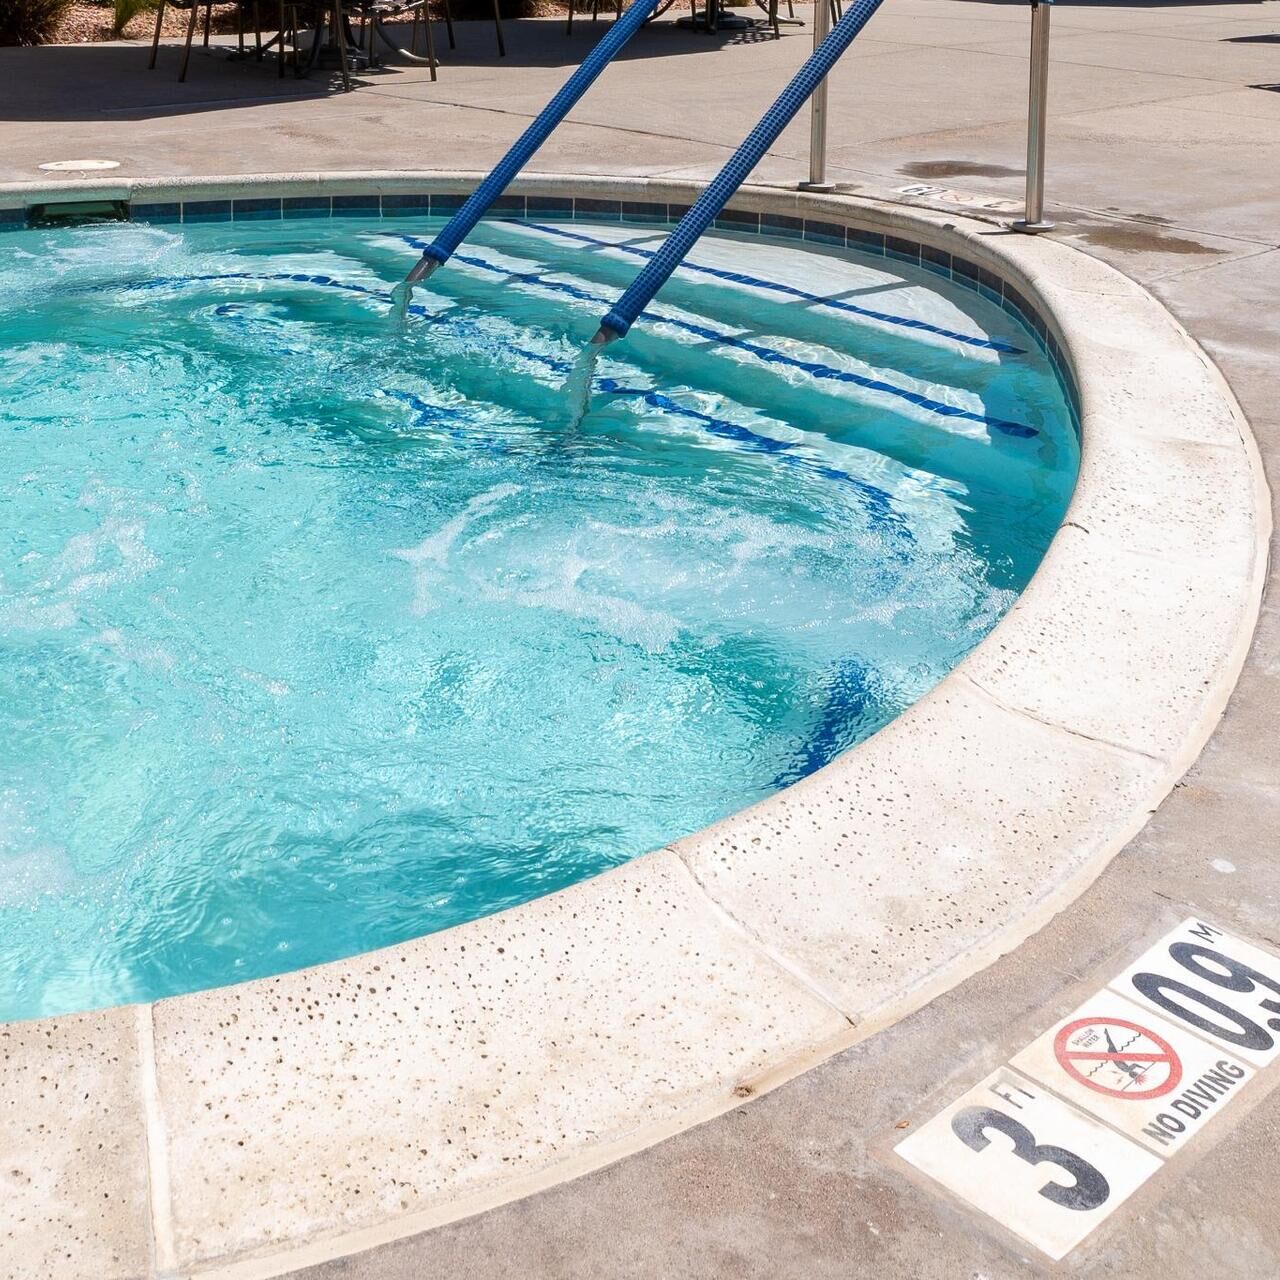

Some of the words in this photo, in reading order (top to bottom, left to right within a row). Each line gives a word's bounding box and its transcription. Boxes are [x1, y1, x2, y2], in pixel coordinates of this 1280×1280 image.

[1188, 922, 1224, 944] M
[1141, 1113, 1186, 1146] NO
[1169, 1059, 1246, 1121] DIVING
[950, 1105, 1110, 1212] 3
